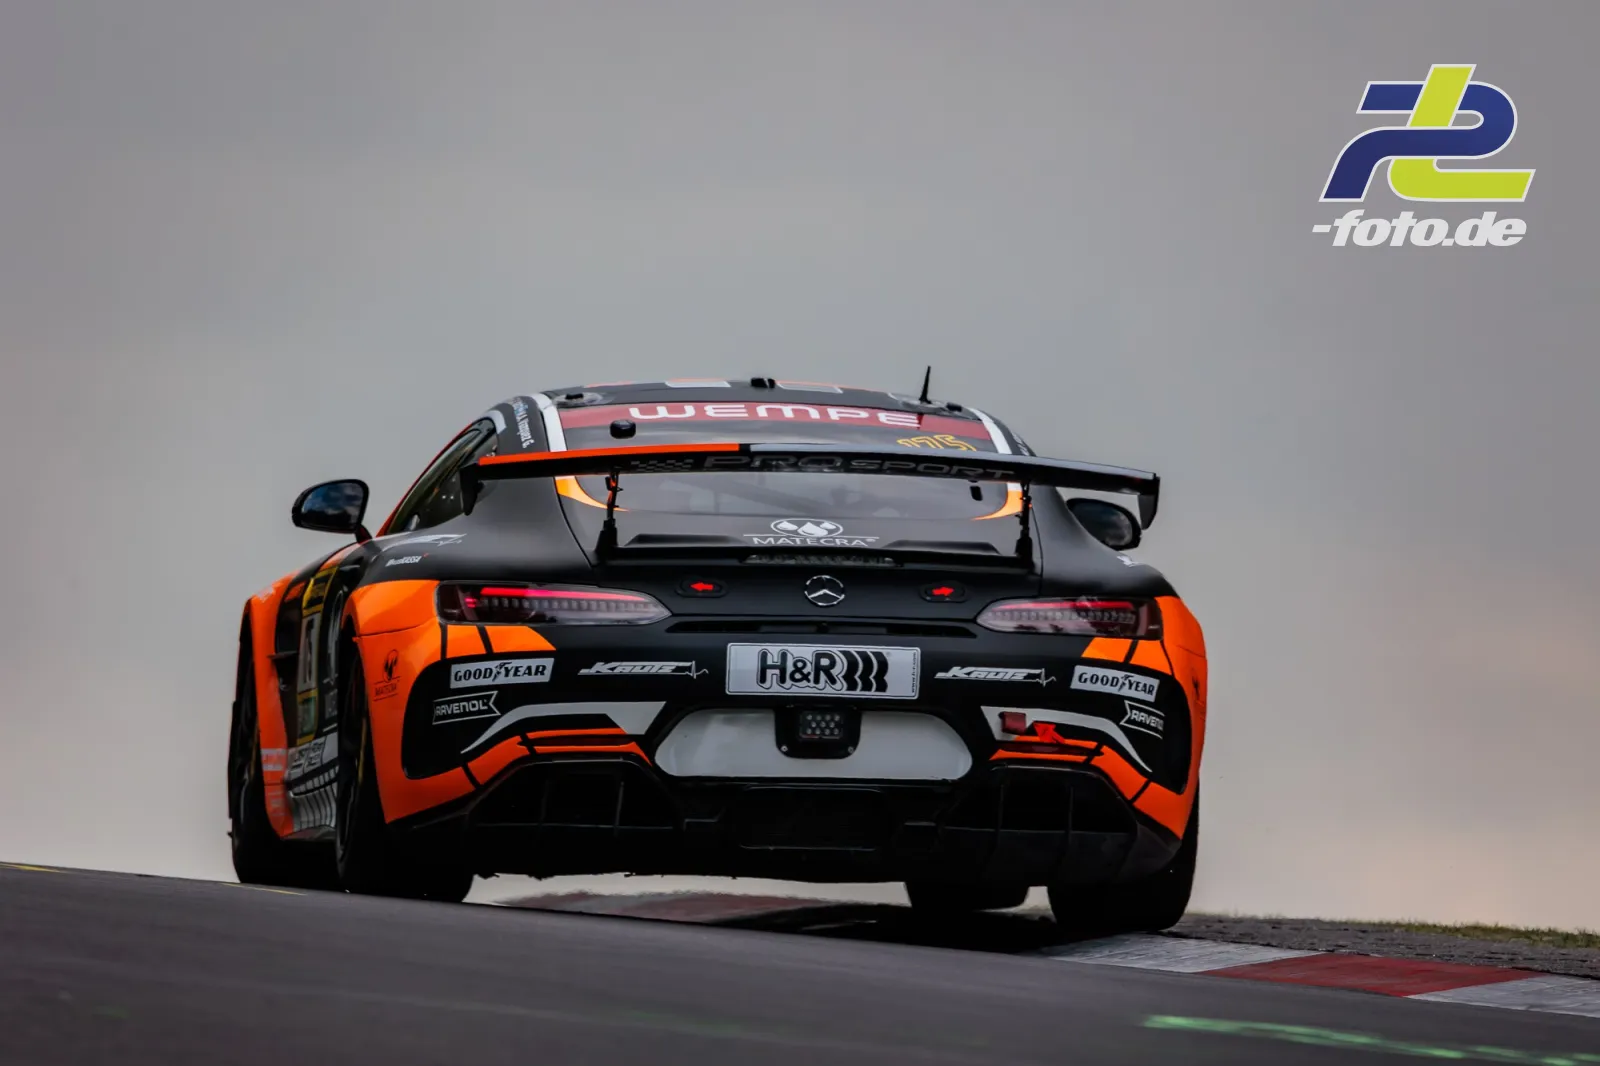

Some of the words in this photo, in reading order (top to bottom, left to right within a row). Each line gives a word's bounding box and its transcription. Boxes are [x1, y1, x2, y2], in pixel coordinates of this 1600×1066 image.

[628, 402, 921, 428] WEMPE
[757, 649, 841, 687] H&R
[435, 699, 488, 717] RAVENOL
